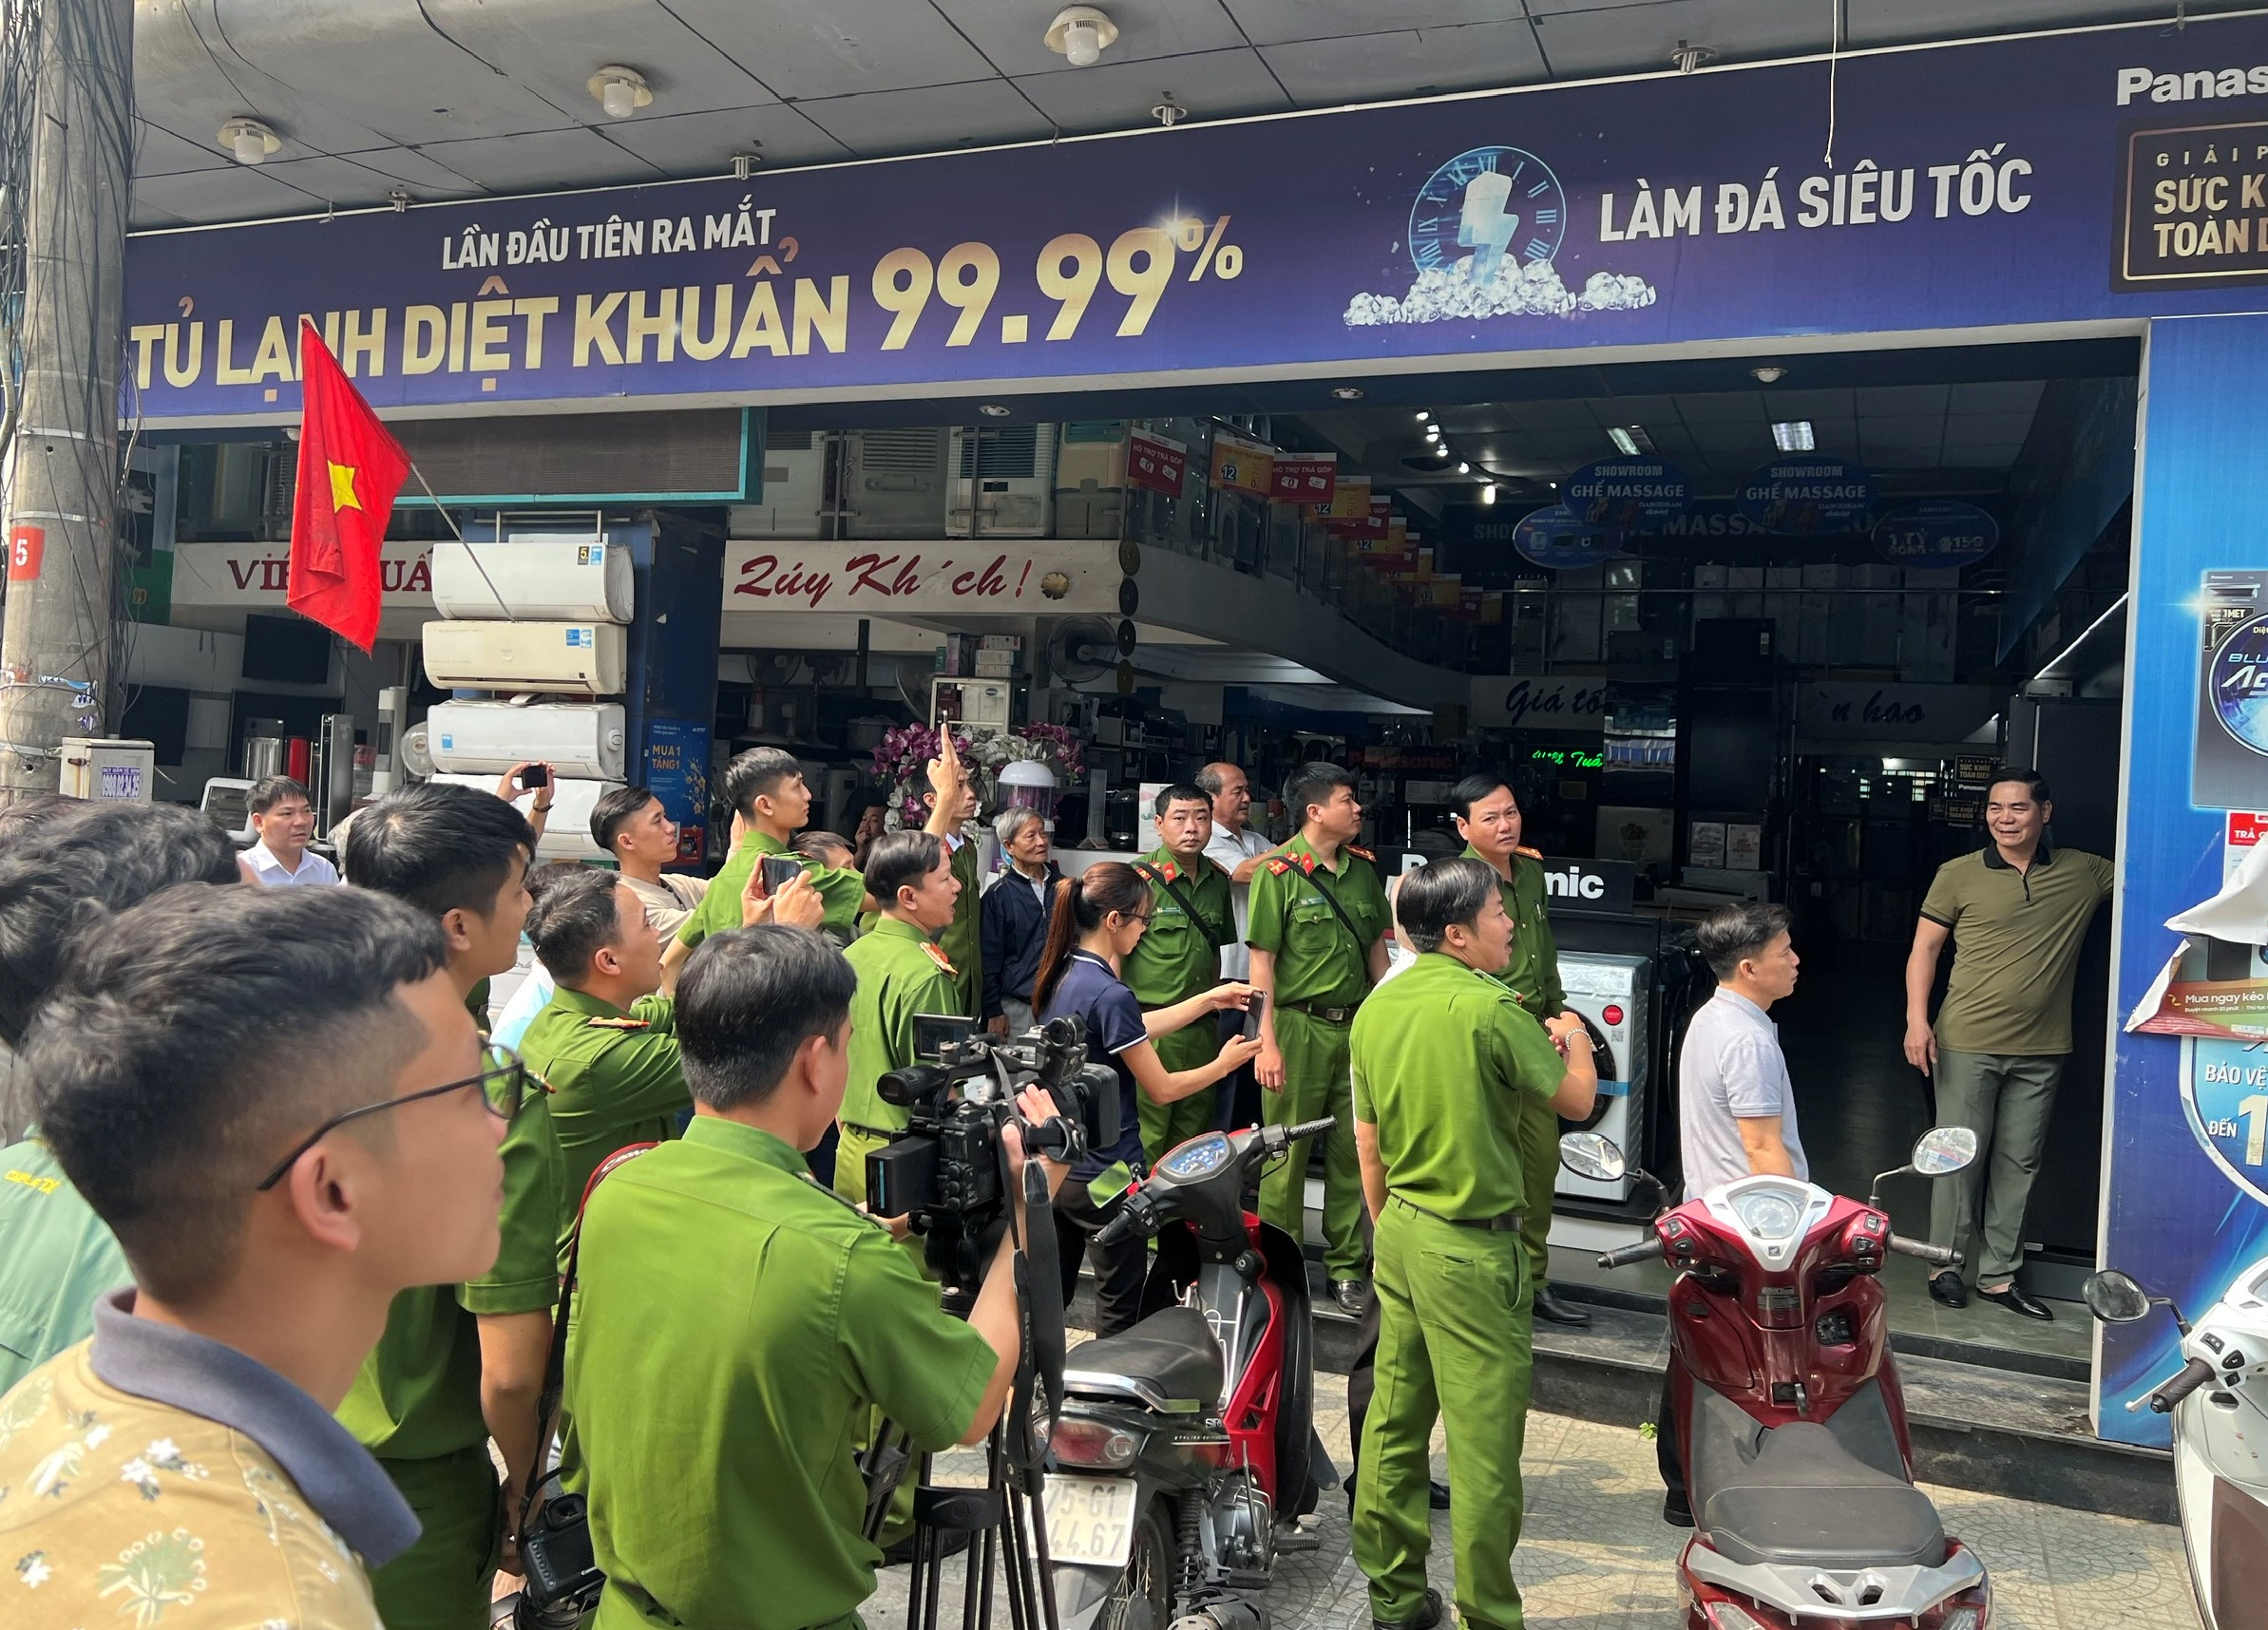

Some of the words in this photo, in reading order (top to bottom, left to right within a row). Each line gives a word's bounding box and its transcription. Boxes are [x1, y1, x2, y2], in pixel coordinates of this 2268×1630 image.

[1600, 178, 1702, 241] LÀM
[1715, 166, 1785, 234] ĐÁ
[1797, 159, 1915, 228] SIÊU
[1928, 142, 2034, 218] TỐC
[2154, 173, 2229, 216] SỨC
[442, 223, 500, 270] LẦN
[506, 218, 569, 265] ĐẦU
[576, 215, 644, 259] TIÊN
[651, 217, 696, 255] RA
[703, 194, 776, 250] MẮT
[2153, 214, 2250, 257] TOÀN
[130, 295, 204, 389] TỦ
[402, 275, 559, 392] DIỆT
[572, 236, 849, 368] KHUẨN
[871, 215, 1245, 351] 99.99%
[1222, 464, 1236, 480] 12
[1594, 464, 1663, 477] SHOWROOM
[1770, 465, 1843, 478] SHOWROOM
[1571, 479, 1605, 498] GHẾ
[1607, 484, 1685, 498] MASSAGE
[1745, 481, 1782, 500] GHẾ
[1784, 485, 1866, 500] MASSAGE
[1315, 502, 1330, 514] 12
[15, 539, 29, 566] 5
[1358, 539, 1371, 549] 12
[1506, 679, 1565, 727] Giá
[652, 744, 676, 757] MUA
[2185, 995, 2209, 1004] Mua
[2210, 994, 2240, 1005] ngay
[2205, 1060, 2241, 1085] BẢO
[2245, 1065, 2268, 1090] VỆ
[2208, 1117, 2238, 1139] ĐẾN
[1049, 1519, 1126, 1558] 44.67
